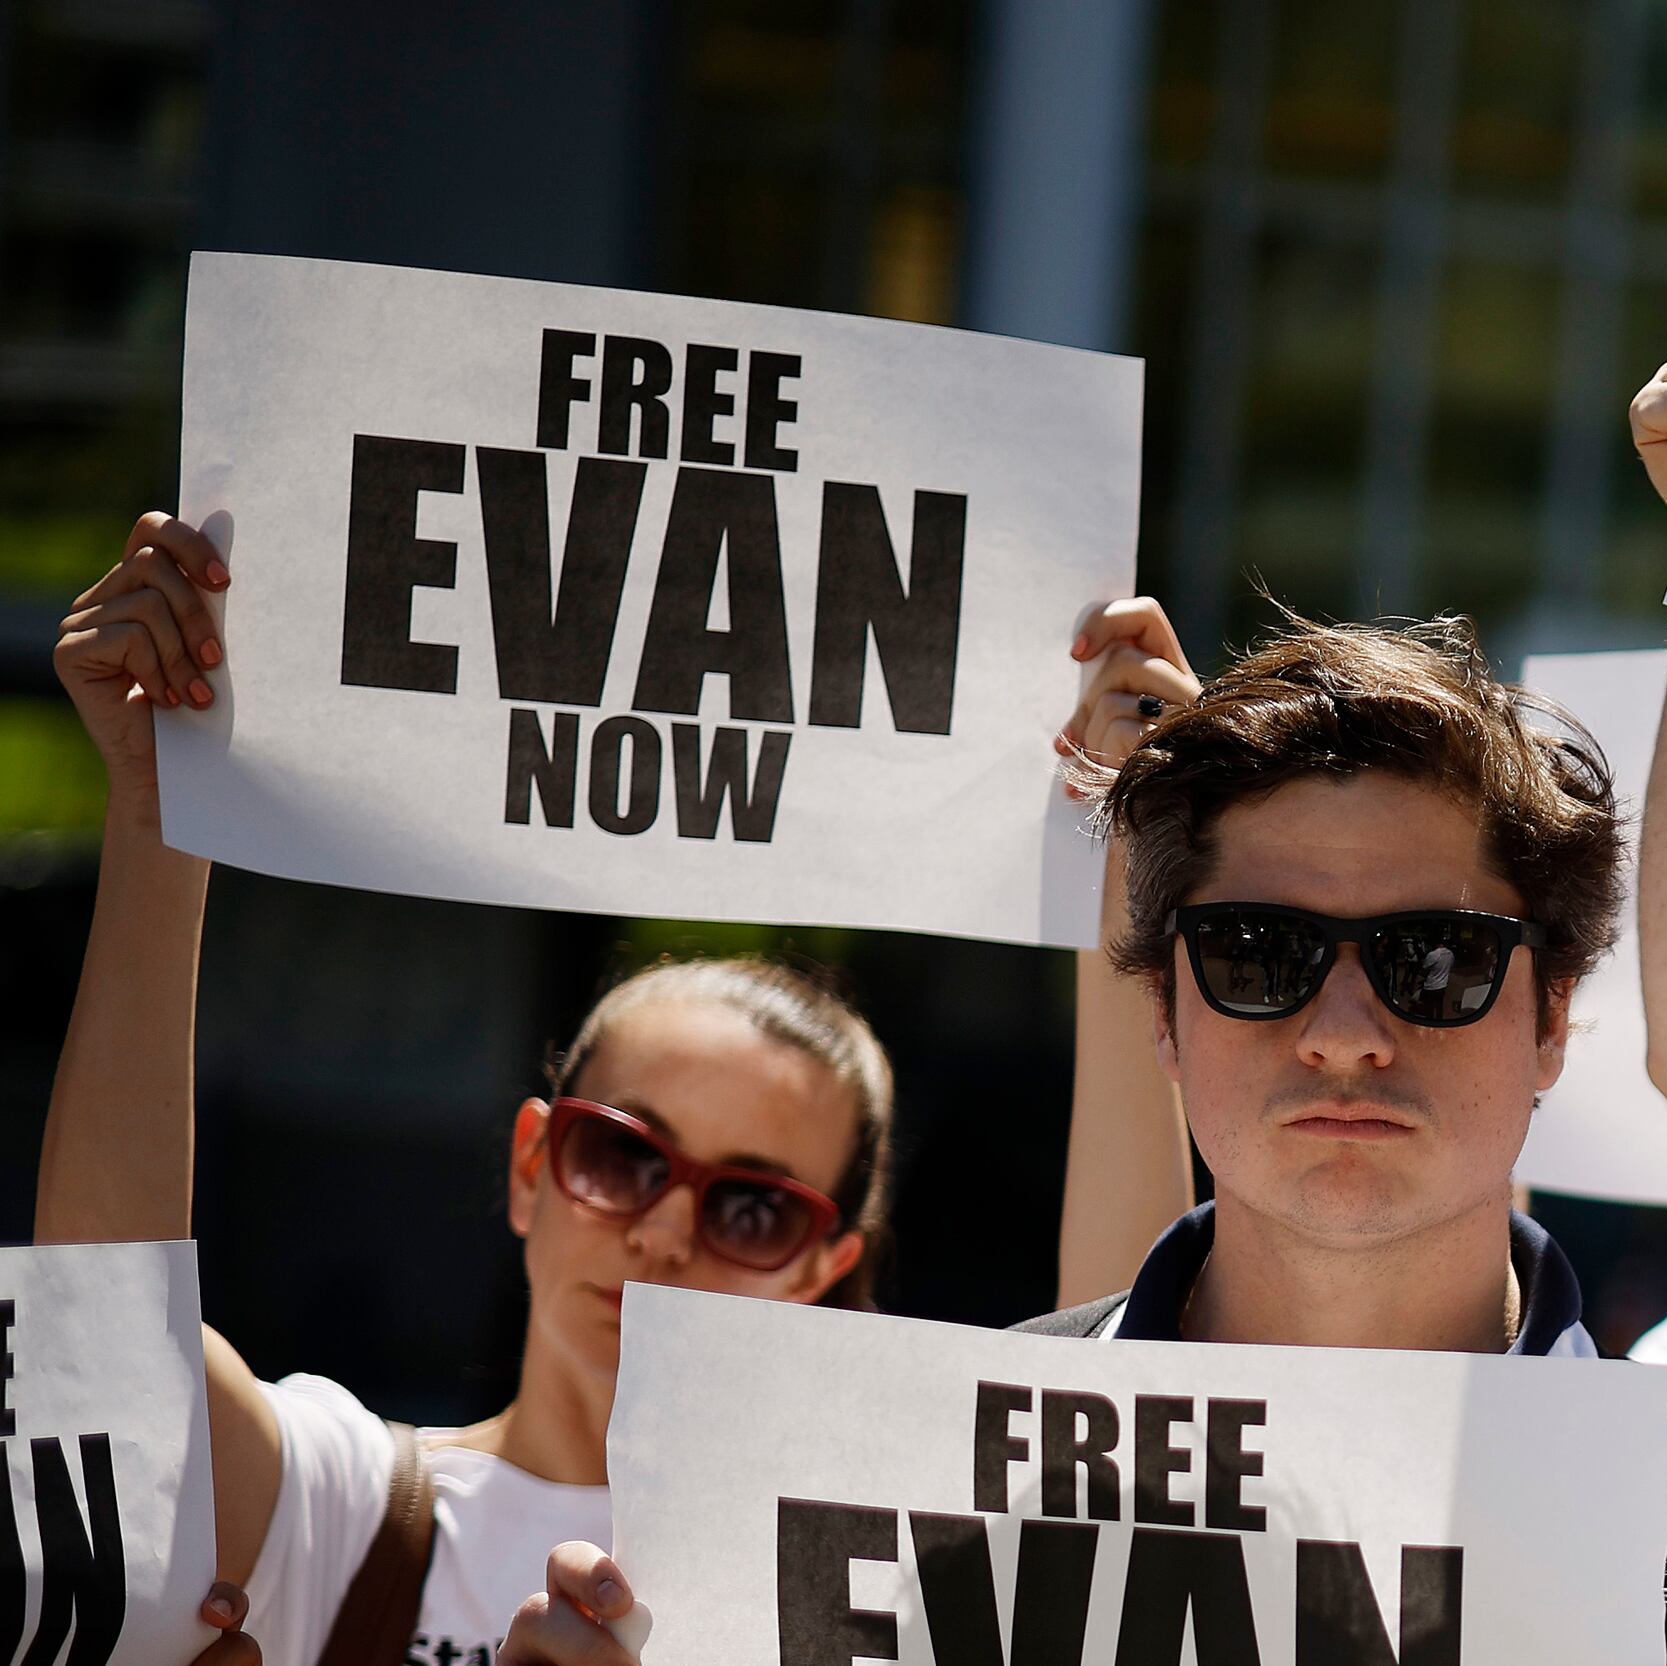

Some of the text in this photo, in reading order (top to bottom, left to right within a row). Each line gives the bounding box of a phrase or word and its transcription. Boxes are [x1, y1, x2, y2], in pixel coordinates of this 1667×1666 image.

[536, 328, 803, 473] FREE
[340, 433, 968, 737] EVAN
[503, 708, 793, 845] NOW
[974, 1379, 1268, 1533] FREE
